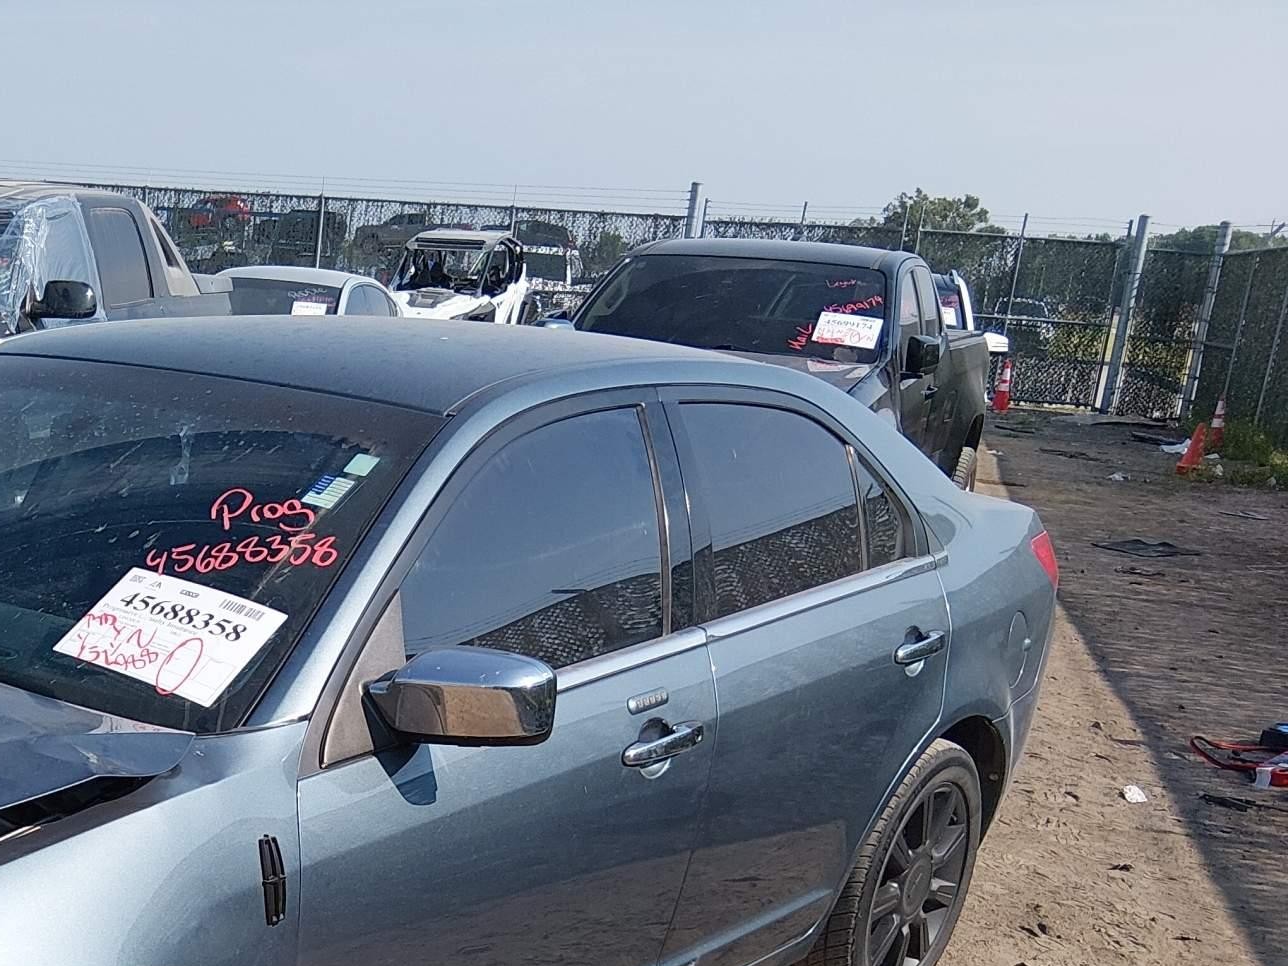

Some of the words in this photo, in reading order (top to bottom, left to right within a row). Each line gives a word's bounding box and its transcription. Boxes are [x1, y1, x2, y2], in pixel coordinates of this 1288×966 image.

[210, 487, 315, 531] Prog
[146, 535, 338, 576] 45688358
[119, 592, 247, 642] 45688358
